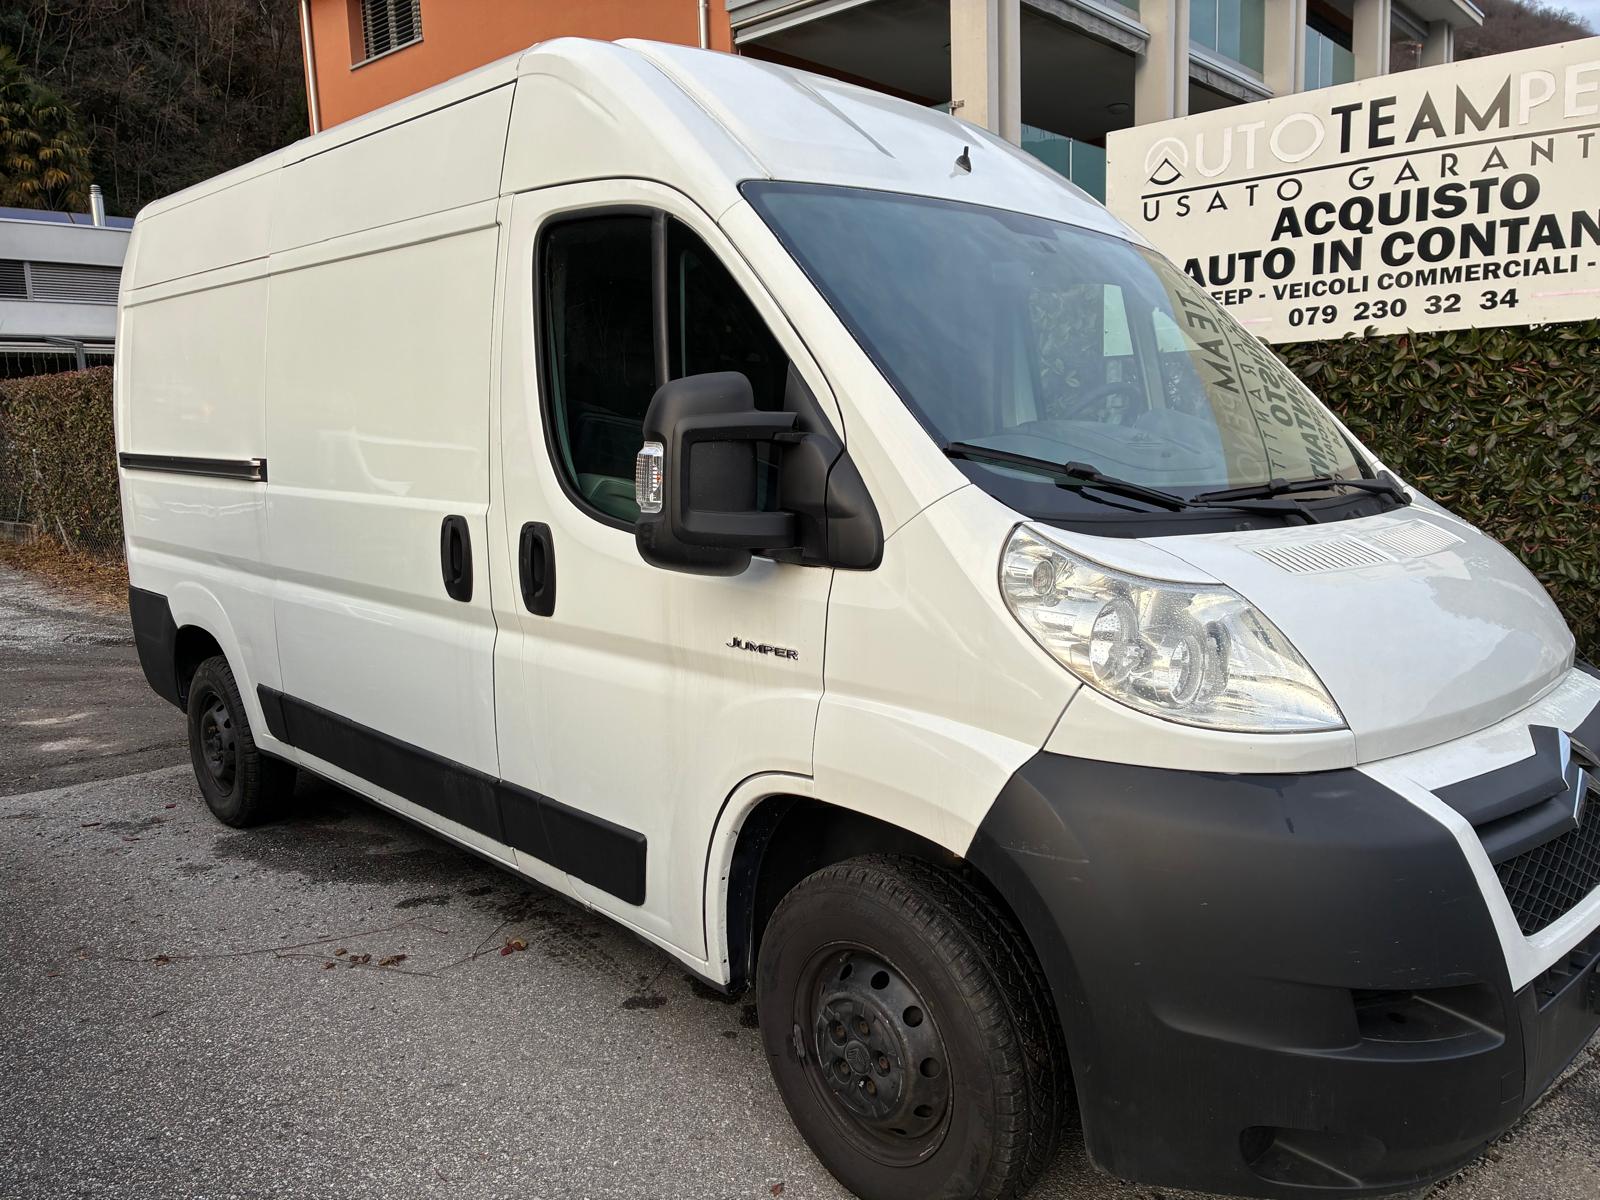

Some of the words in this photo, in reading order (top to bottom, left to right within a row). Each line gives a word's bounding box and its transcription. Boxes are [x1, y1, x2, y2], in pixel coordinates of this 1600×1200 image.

[1143, 178, 1303, 222] USATO
[1349, 132, 1595, 191] GARANT
[1271, 173, 1541, 241] ACQUISTO
[1184, 247, 1296, 287] AUTO
[1312, 236, 1363, 275] IN
[1211, 288, 1253, 306] EEP
[1272, 275, 1369, 300] VEICOLI
[1377, 254, 1578, 290] COMMERCIALI
[1288, 304, 1338, 327] 079
[1353, 298, 1407, 321] 230
[1424, 293, 1462, 314] 32
[1479, 288, 1519, 310] 34
[726, 636, 799, 661] JUMPER
